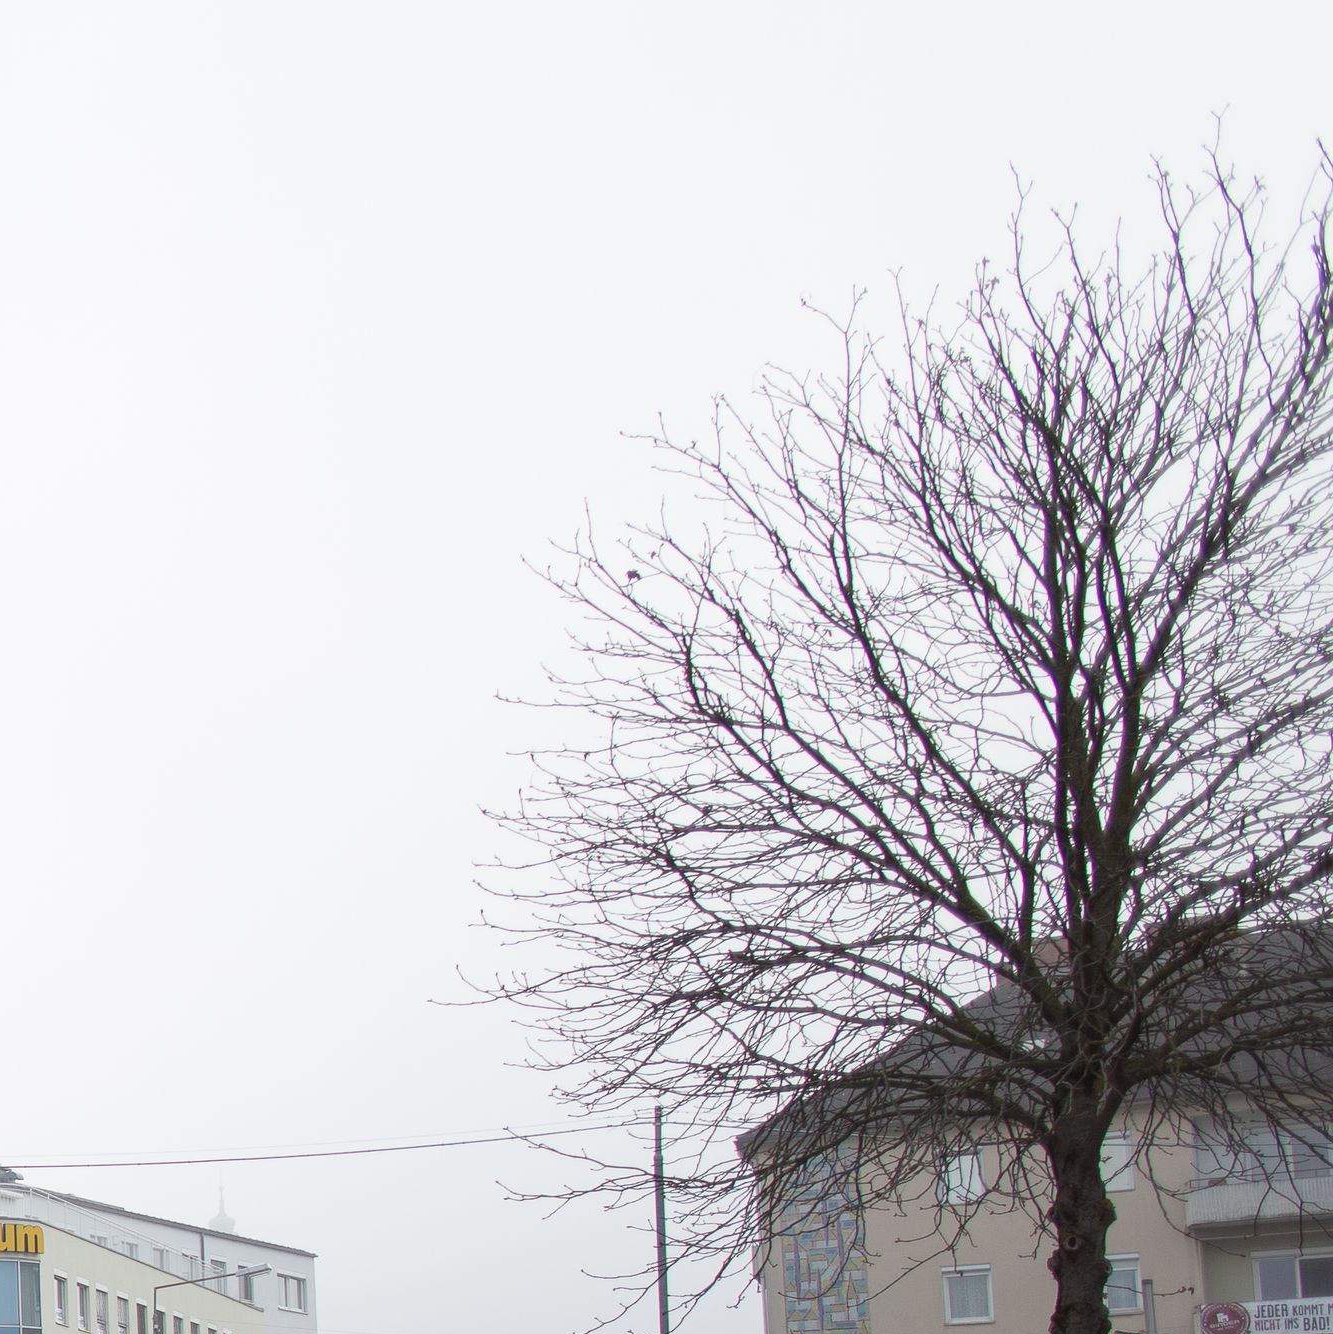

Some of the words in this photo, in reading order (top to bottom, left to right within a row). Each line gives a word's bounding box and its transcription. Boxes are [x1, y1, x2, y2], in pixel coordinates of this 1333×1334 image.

[1254, 1303, 1289, 1319] JEDER
[1292, 1303, 1325, 1316] KOMMT
[1254, 1318, 1282, 1331] NICHT
[1284, 1317, 1299, 1330] INS
[1303, 1316, 1330, 1331] BAD!
